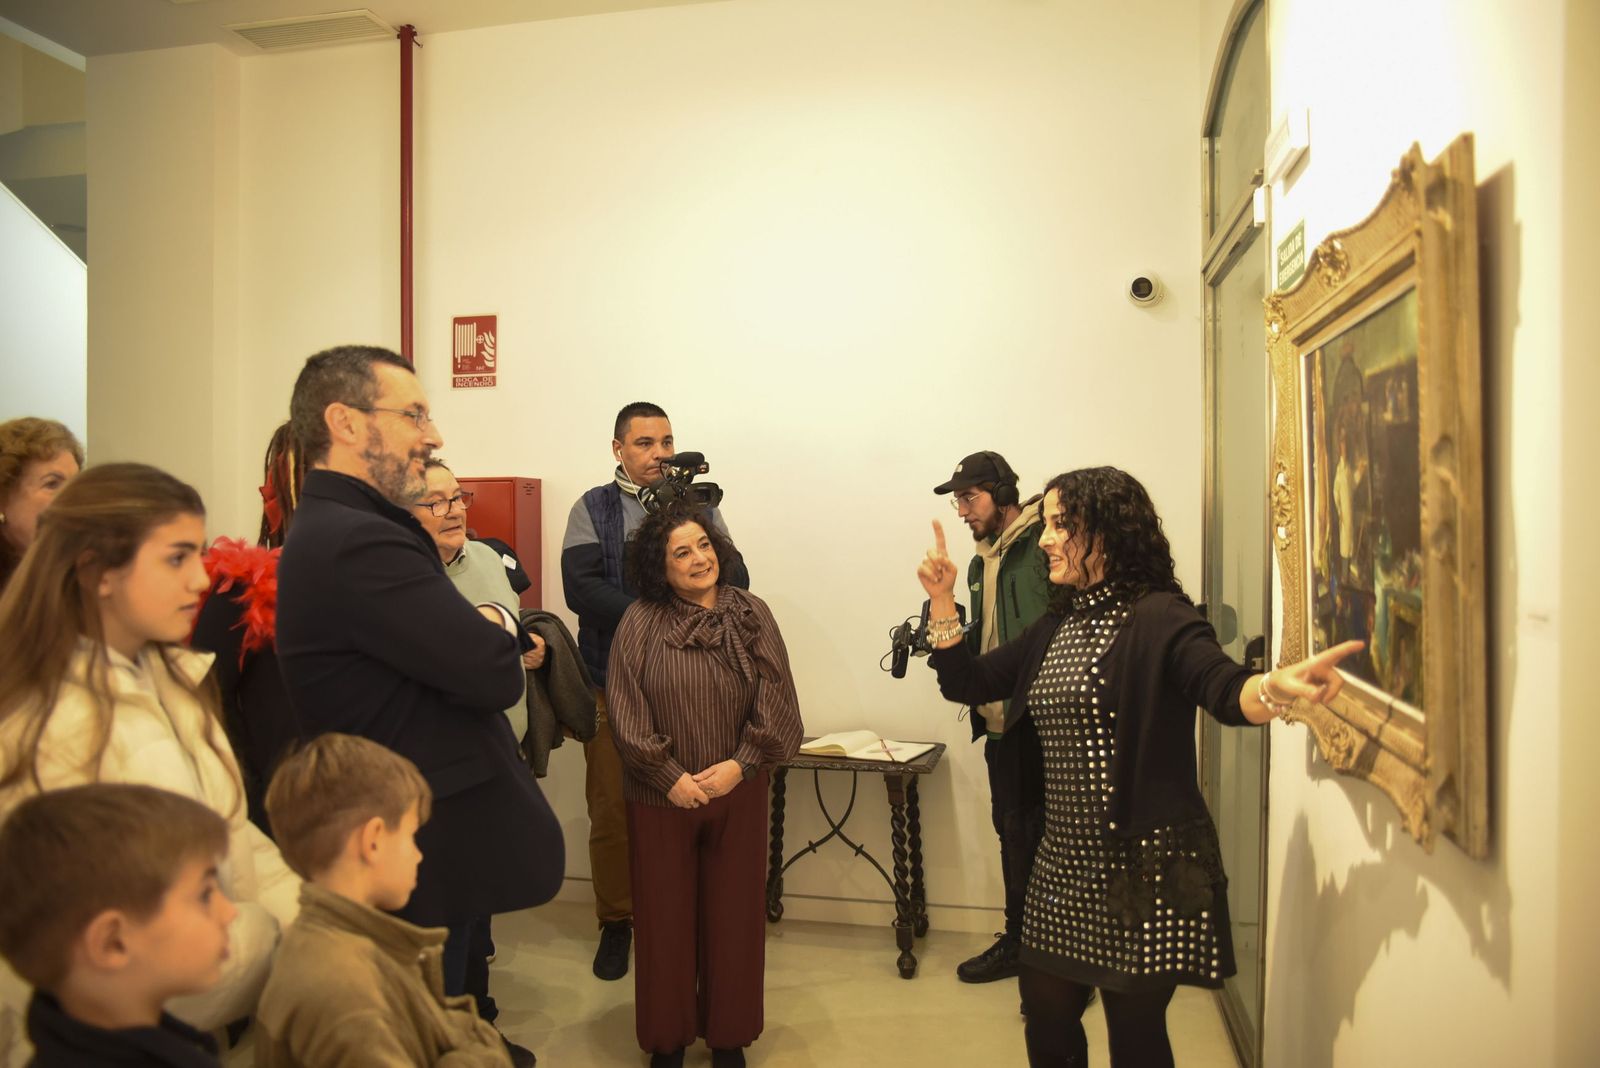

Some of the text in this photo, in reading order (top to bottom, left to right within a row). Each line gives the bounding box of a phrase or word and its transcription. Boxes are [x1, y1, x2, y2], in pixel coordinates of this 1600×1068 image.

[1280, 231, 1302, 266] SALIDA DE
[1279, 250, 1304, 286] EMERGENCIA
